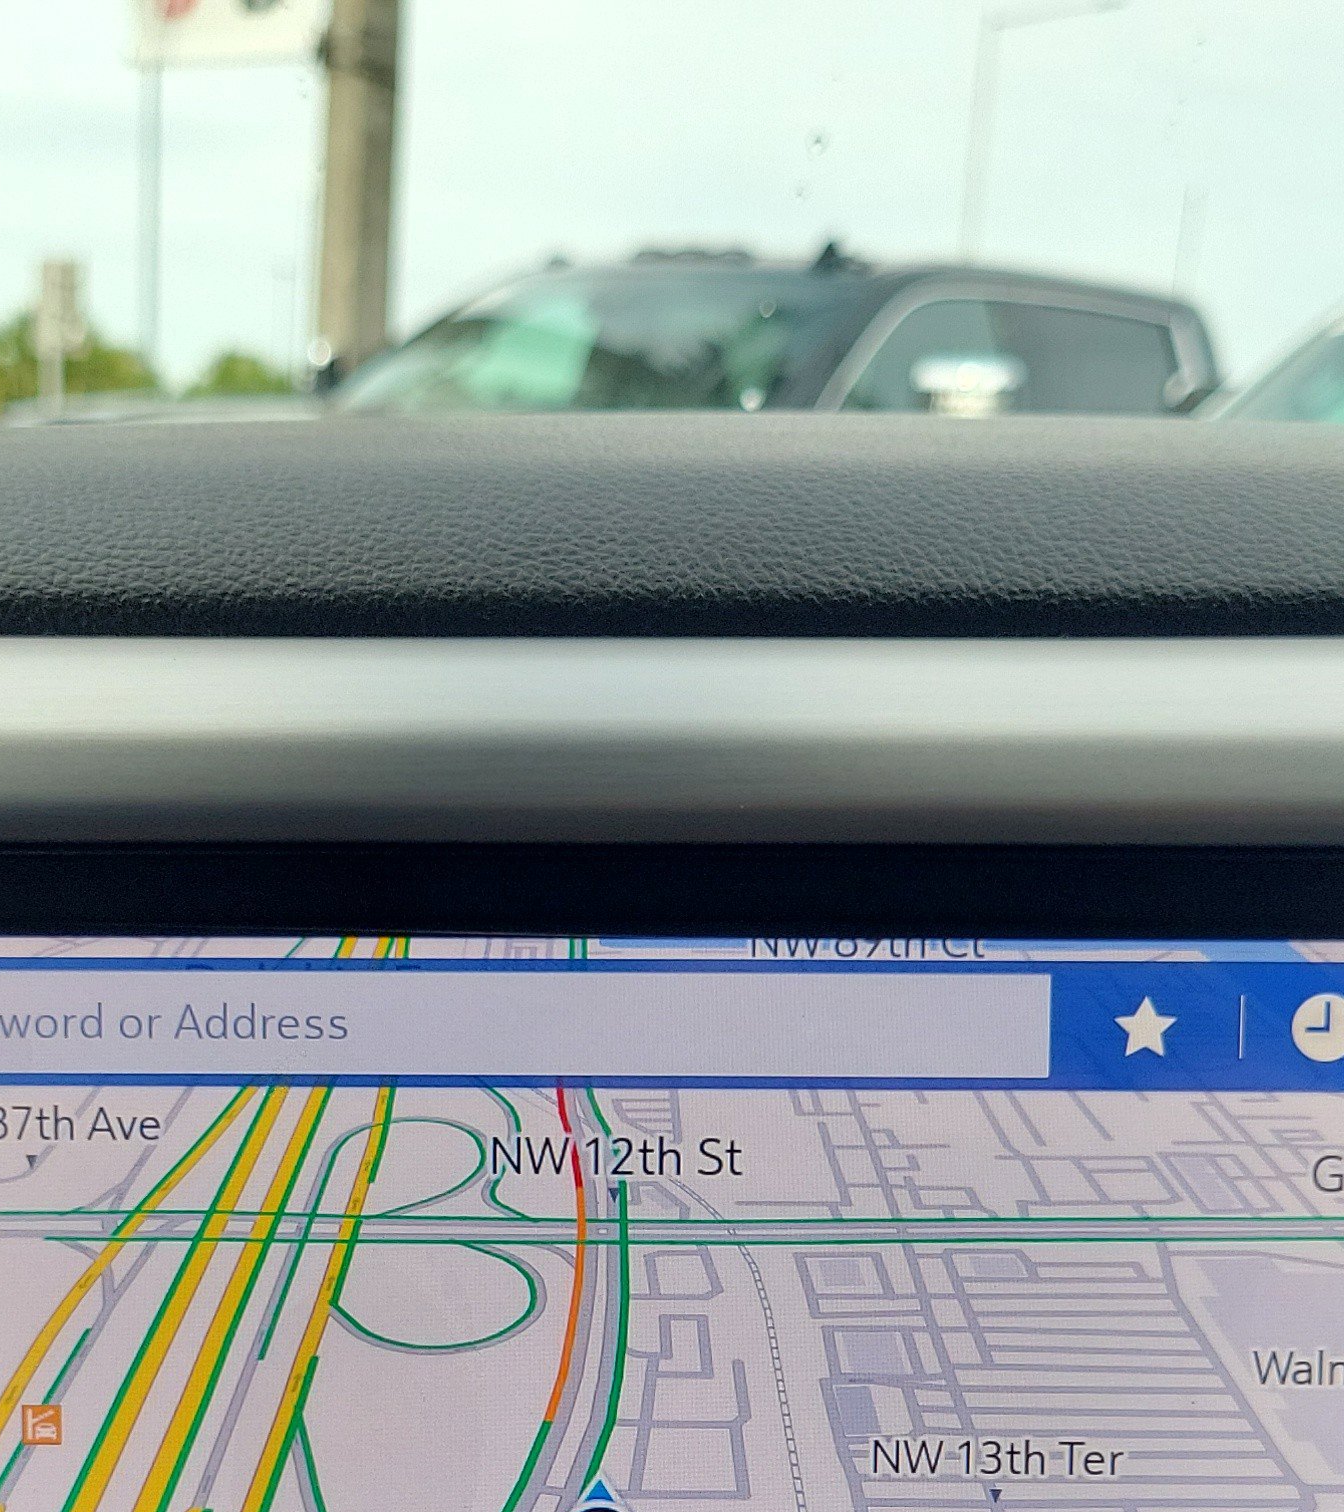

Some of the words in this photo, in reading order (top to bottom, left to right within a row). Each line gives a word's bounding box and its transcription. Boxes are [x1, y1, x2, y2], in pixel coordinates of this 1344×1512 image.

[751, 938, 819, 958] NW
[119, 1011, 162, 1040] or
[173, 1002, 350, 1041] Address
[87, 1107, 161, 1141] Ave
[491, 1137, 570, 1175] NW
[585, 1137, 683, 1176] 12th
[697, 1138, 743, 1176] St
[871, 1439, 945, 1475] NW
[958, 1439, 1046, 1476] 13th
[1060, 1441, 1125, 1476] Ter
